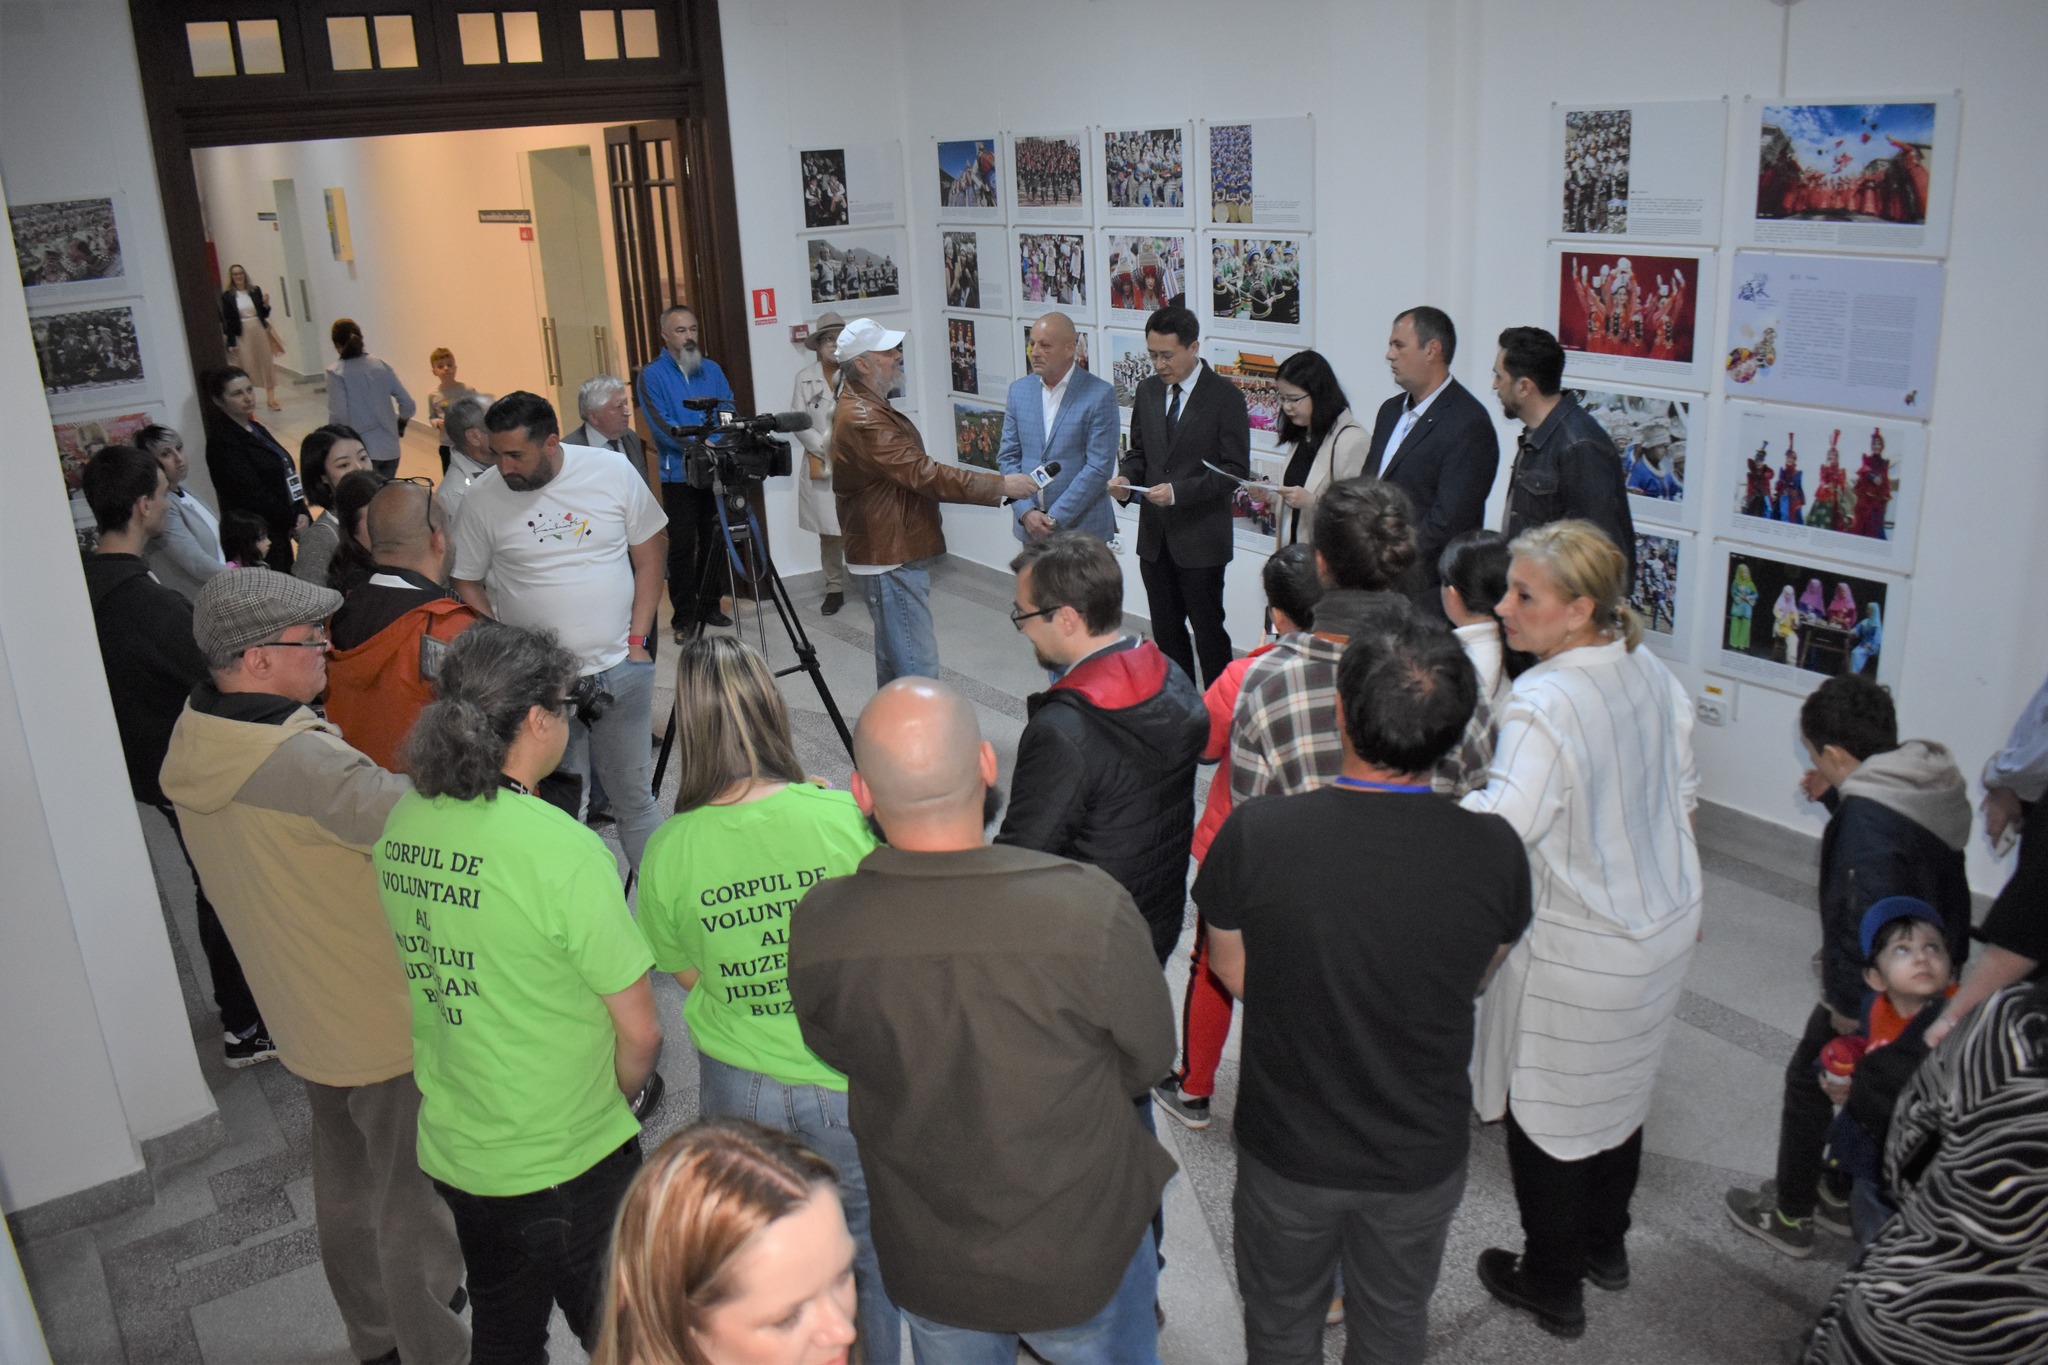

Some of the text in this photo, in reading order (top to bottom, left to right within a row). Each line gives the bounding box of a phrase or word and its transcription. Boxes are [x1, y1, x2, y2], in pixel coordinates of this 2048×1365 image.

[385, 840, 484, 876] CORPUL DE
[382, 870, 481, 909] VOLUNTARI
[700, 873, 792, 907] CORPUL
[416, 908, 431, 931] AL
[701, 899, 799, 933] VOLUNT
[761, 929, 790, 946] AL
[718, 953, 788, 978] MUZE
[750, 1001, 796, 1016] BUZ
